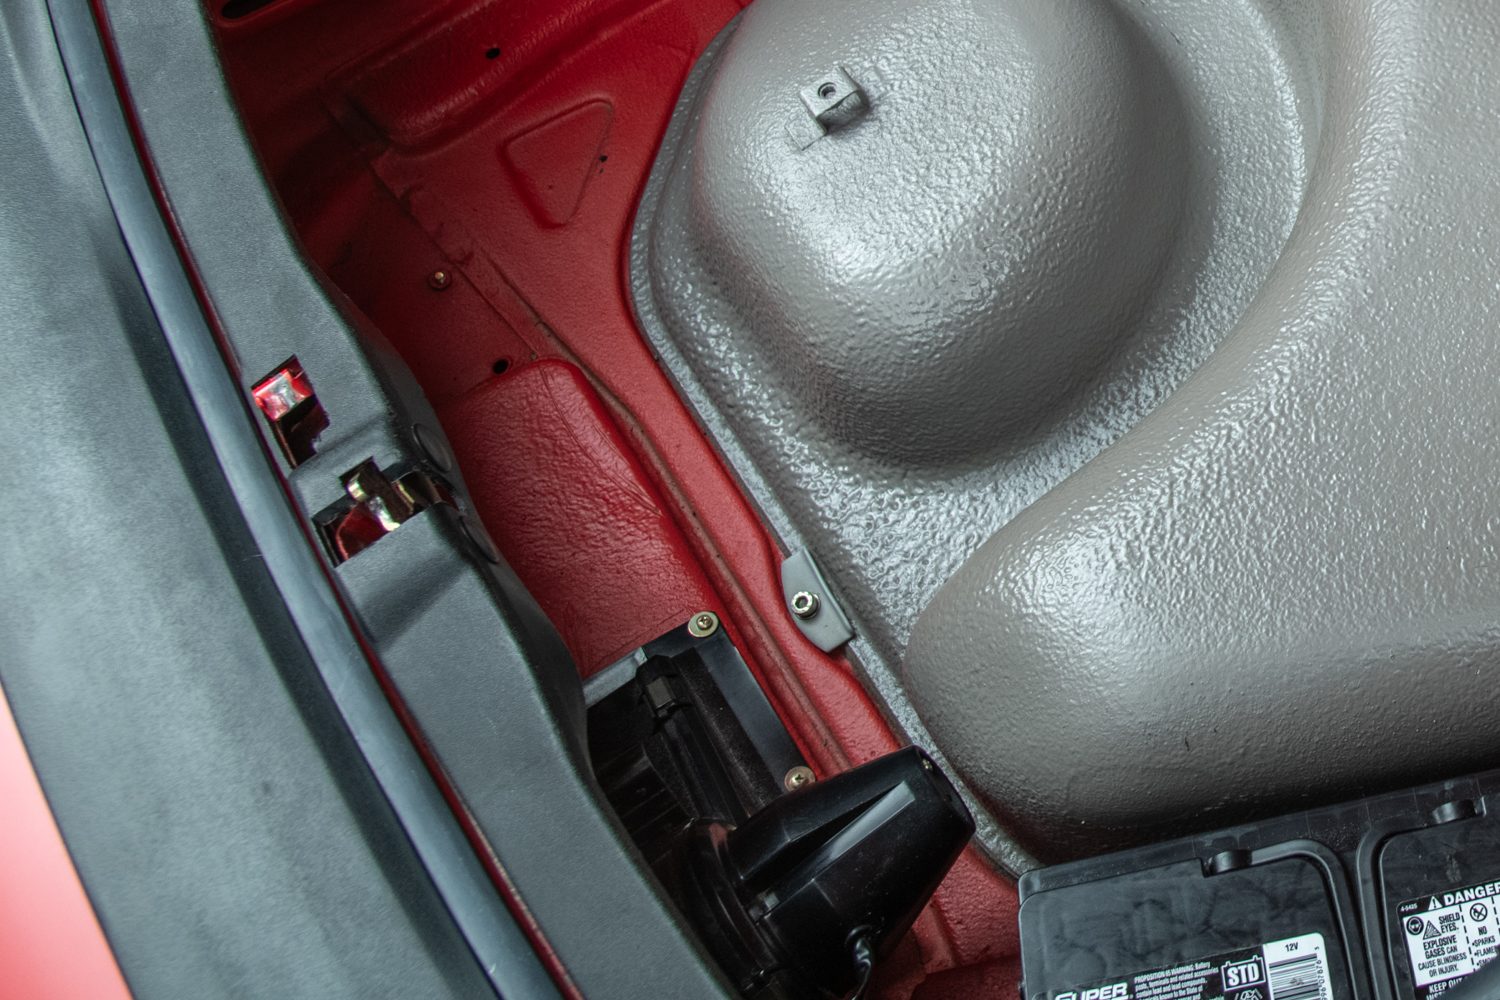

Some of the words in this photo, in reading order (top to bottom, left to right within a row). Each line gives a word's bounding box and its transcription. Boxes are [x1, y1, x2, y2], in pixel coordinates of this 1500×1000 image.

[1438, 912, 1460, 924] SHIELD
[1440, 922, 1459, 934] EYES.
[1478, 925, 1488, 936] NO
[1285, 942, 1299, 952] 12V
[1423, 934, 1457, 950] EXPLOSIVE
[1425, 947, 1446, 959] GASES
[1446, 945, 1458, 954] CAN
[1418, 960, 1437, 971] CAUSE
[1437, 952, 1468, 966] BLINDNESS
[1226, 962, 1260, 987] STD
[1428, 968, 1438, 978] OR
[1055, 982, 1128, 1000] SUPER
[1428, 981, 1447, 994] KEEP
